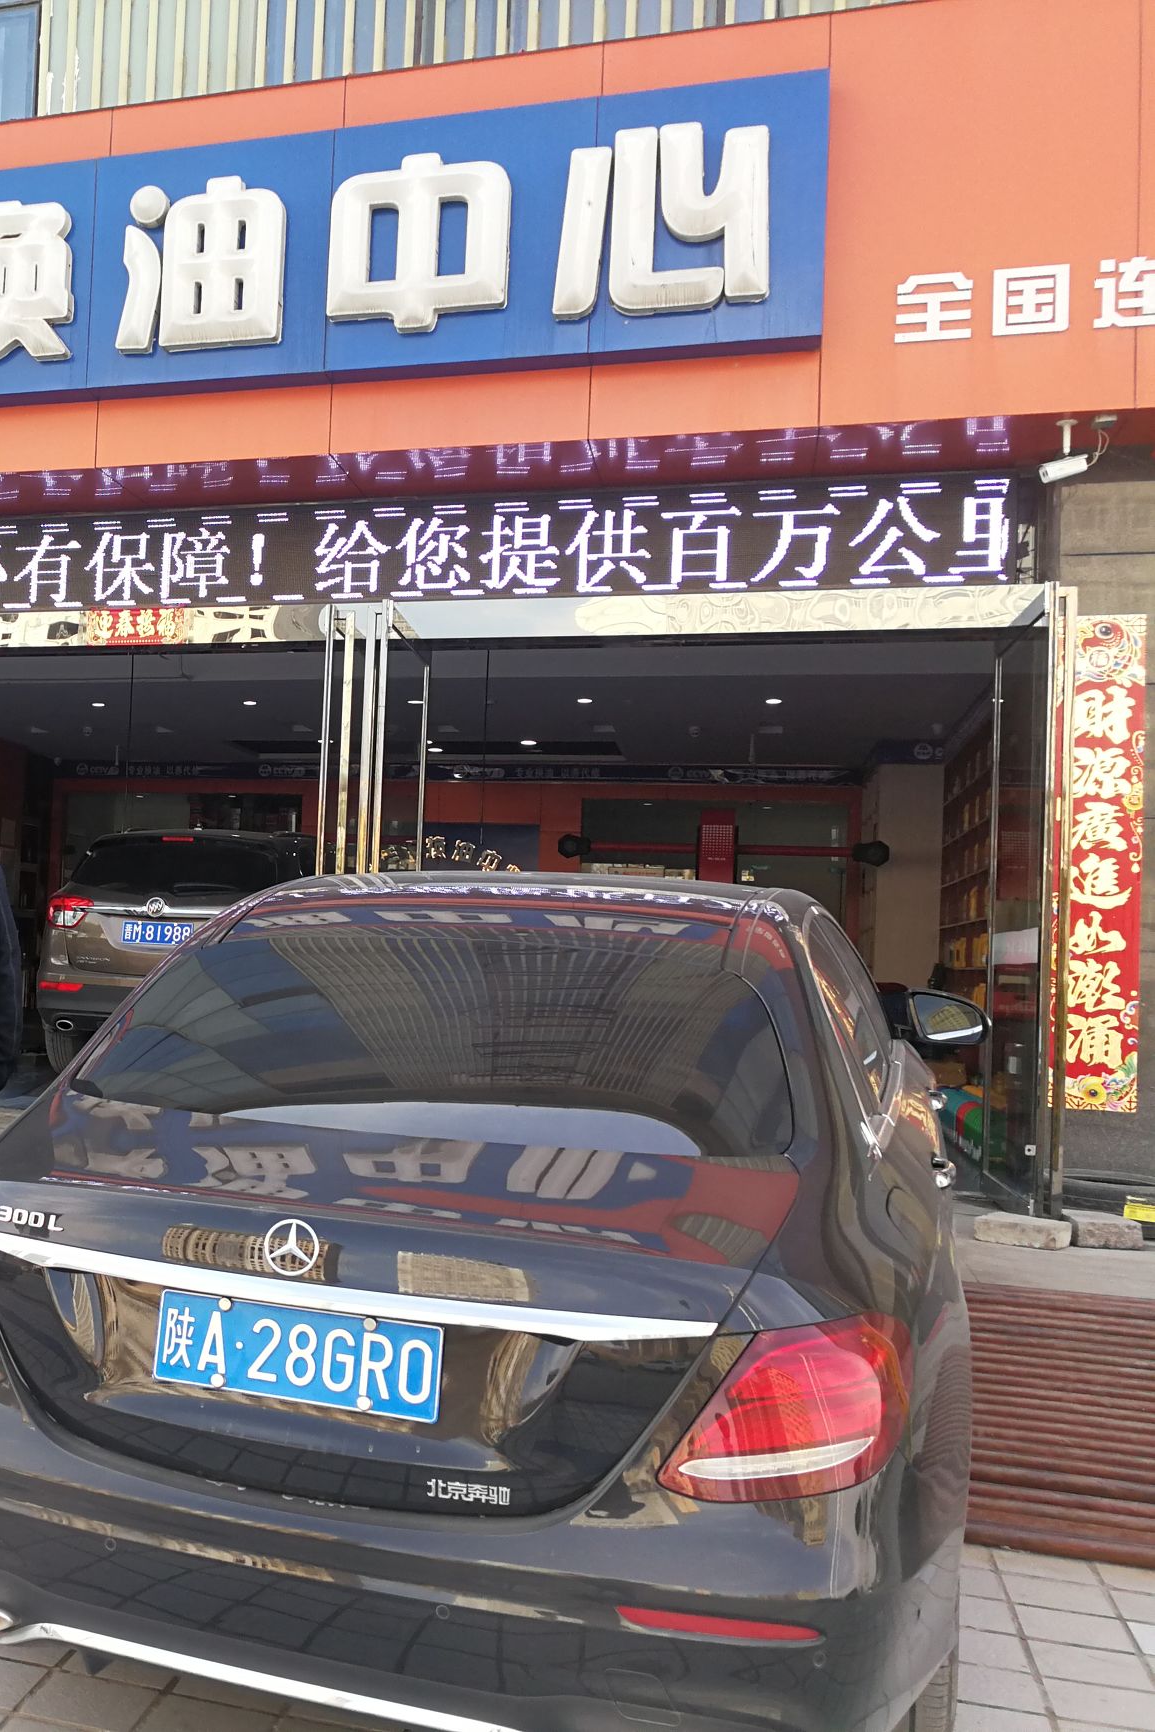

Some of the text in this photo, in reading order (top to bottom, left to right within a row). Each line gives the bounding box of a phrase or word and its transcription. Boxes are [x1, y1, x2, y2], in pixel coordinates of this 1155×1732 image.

[894, 256, 1155, 343] 全国连
[426, 1478, 511, 1506] 北京奔驰
